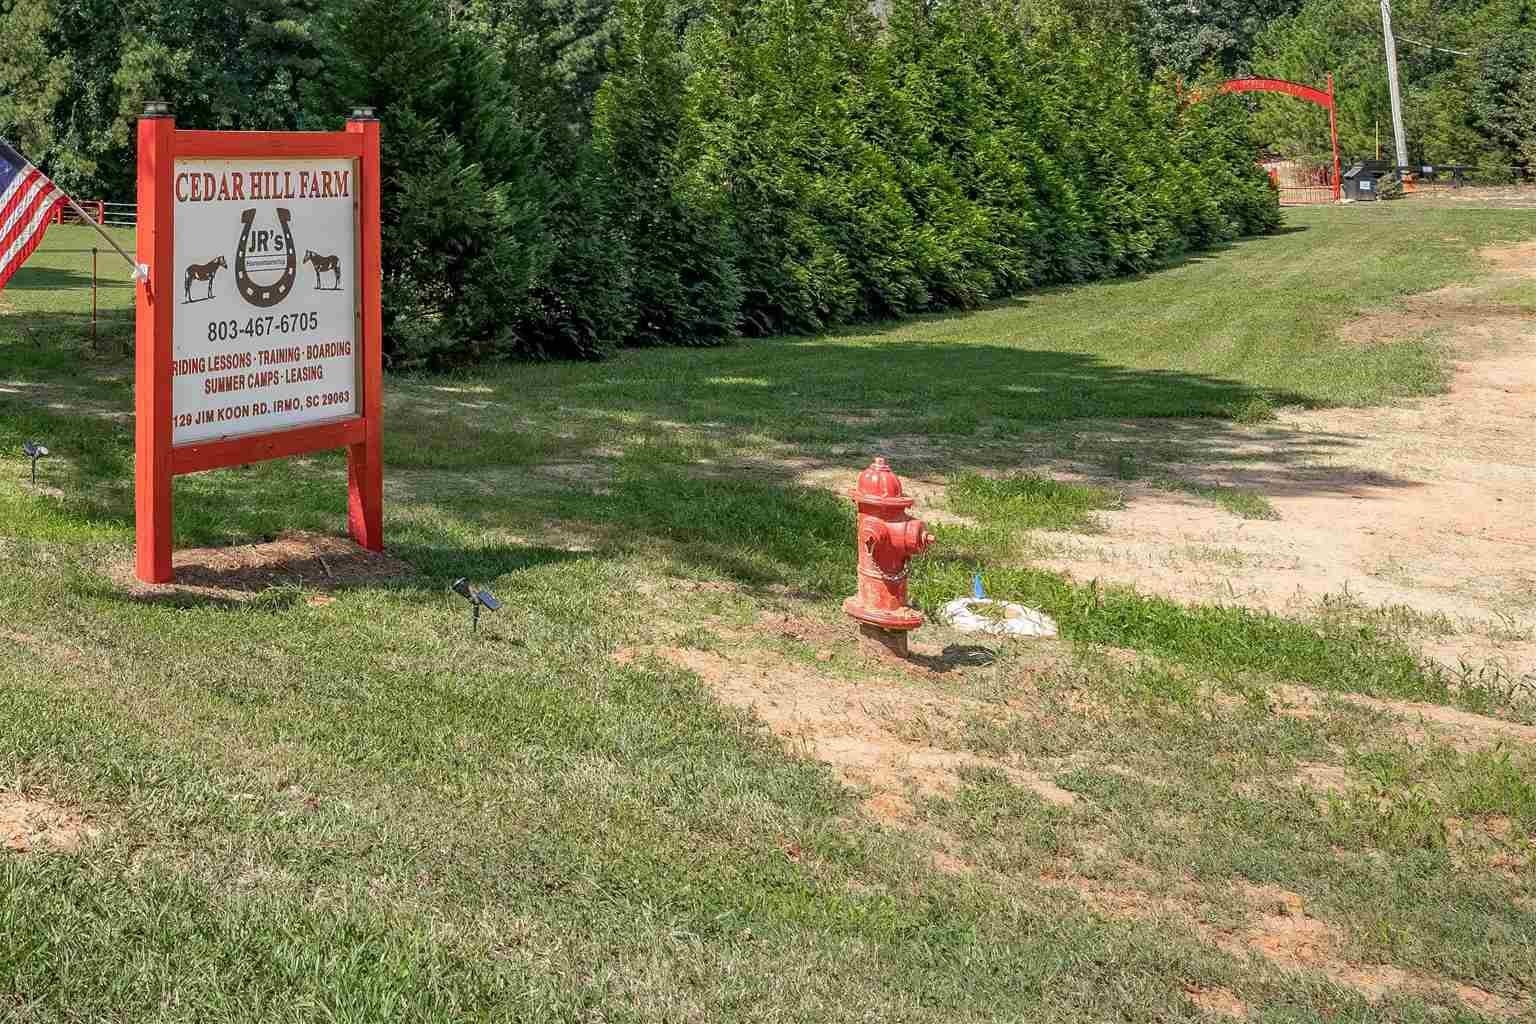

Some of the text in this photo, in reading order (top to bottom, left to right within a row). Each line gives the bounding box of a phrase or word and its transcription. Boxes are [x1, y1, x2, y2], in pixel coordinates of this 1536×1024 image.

[175, 170, 350, 202] CEDAR HILL FARM
[249, 230, 284, 252] JR's
[207, 311, 318, 342] 803-467-6705
[171, 341, 351, 376] RIDING LESSONS TRAINING BOARDING
[204, 364, 323, 394] SUMMER CAMPS LEASING
[195, 409, 214, 425] JIM
[217, 405, 250, 422] KOON
[306, 395, 320, 408] SC
